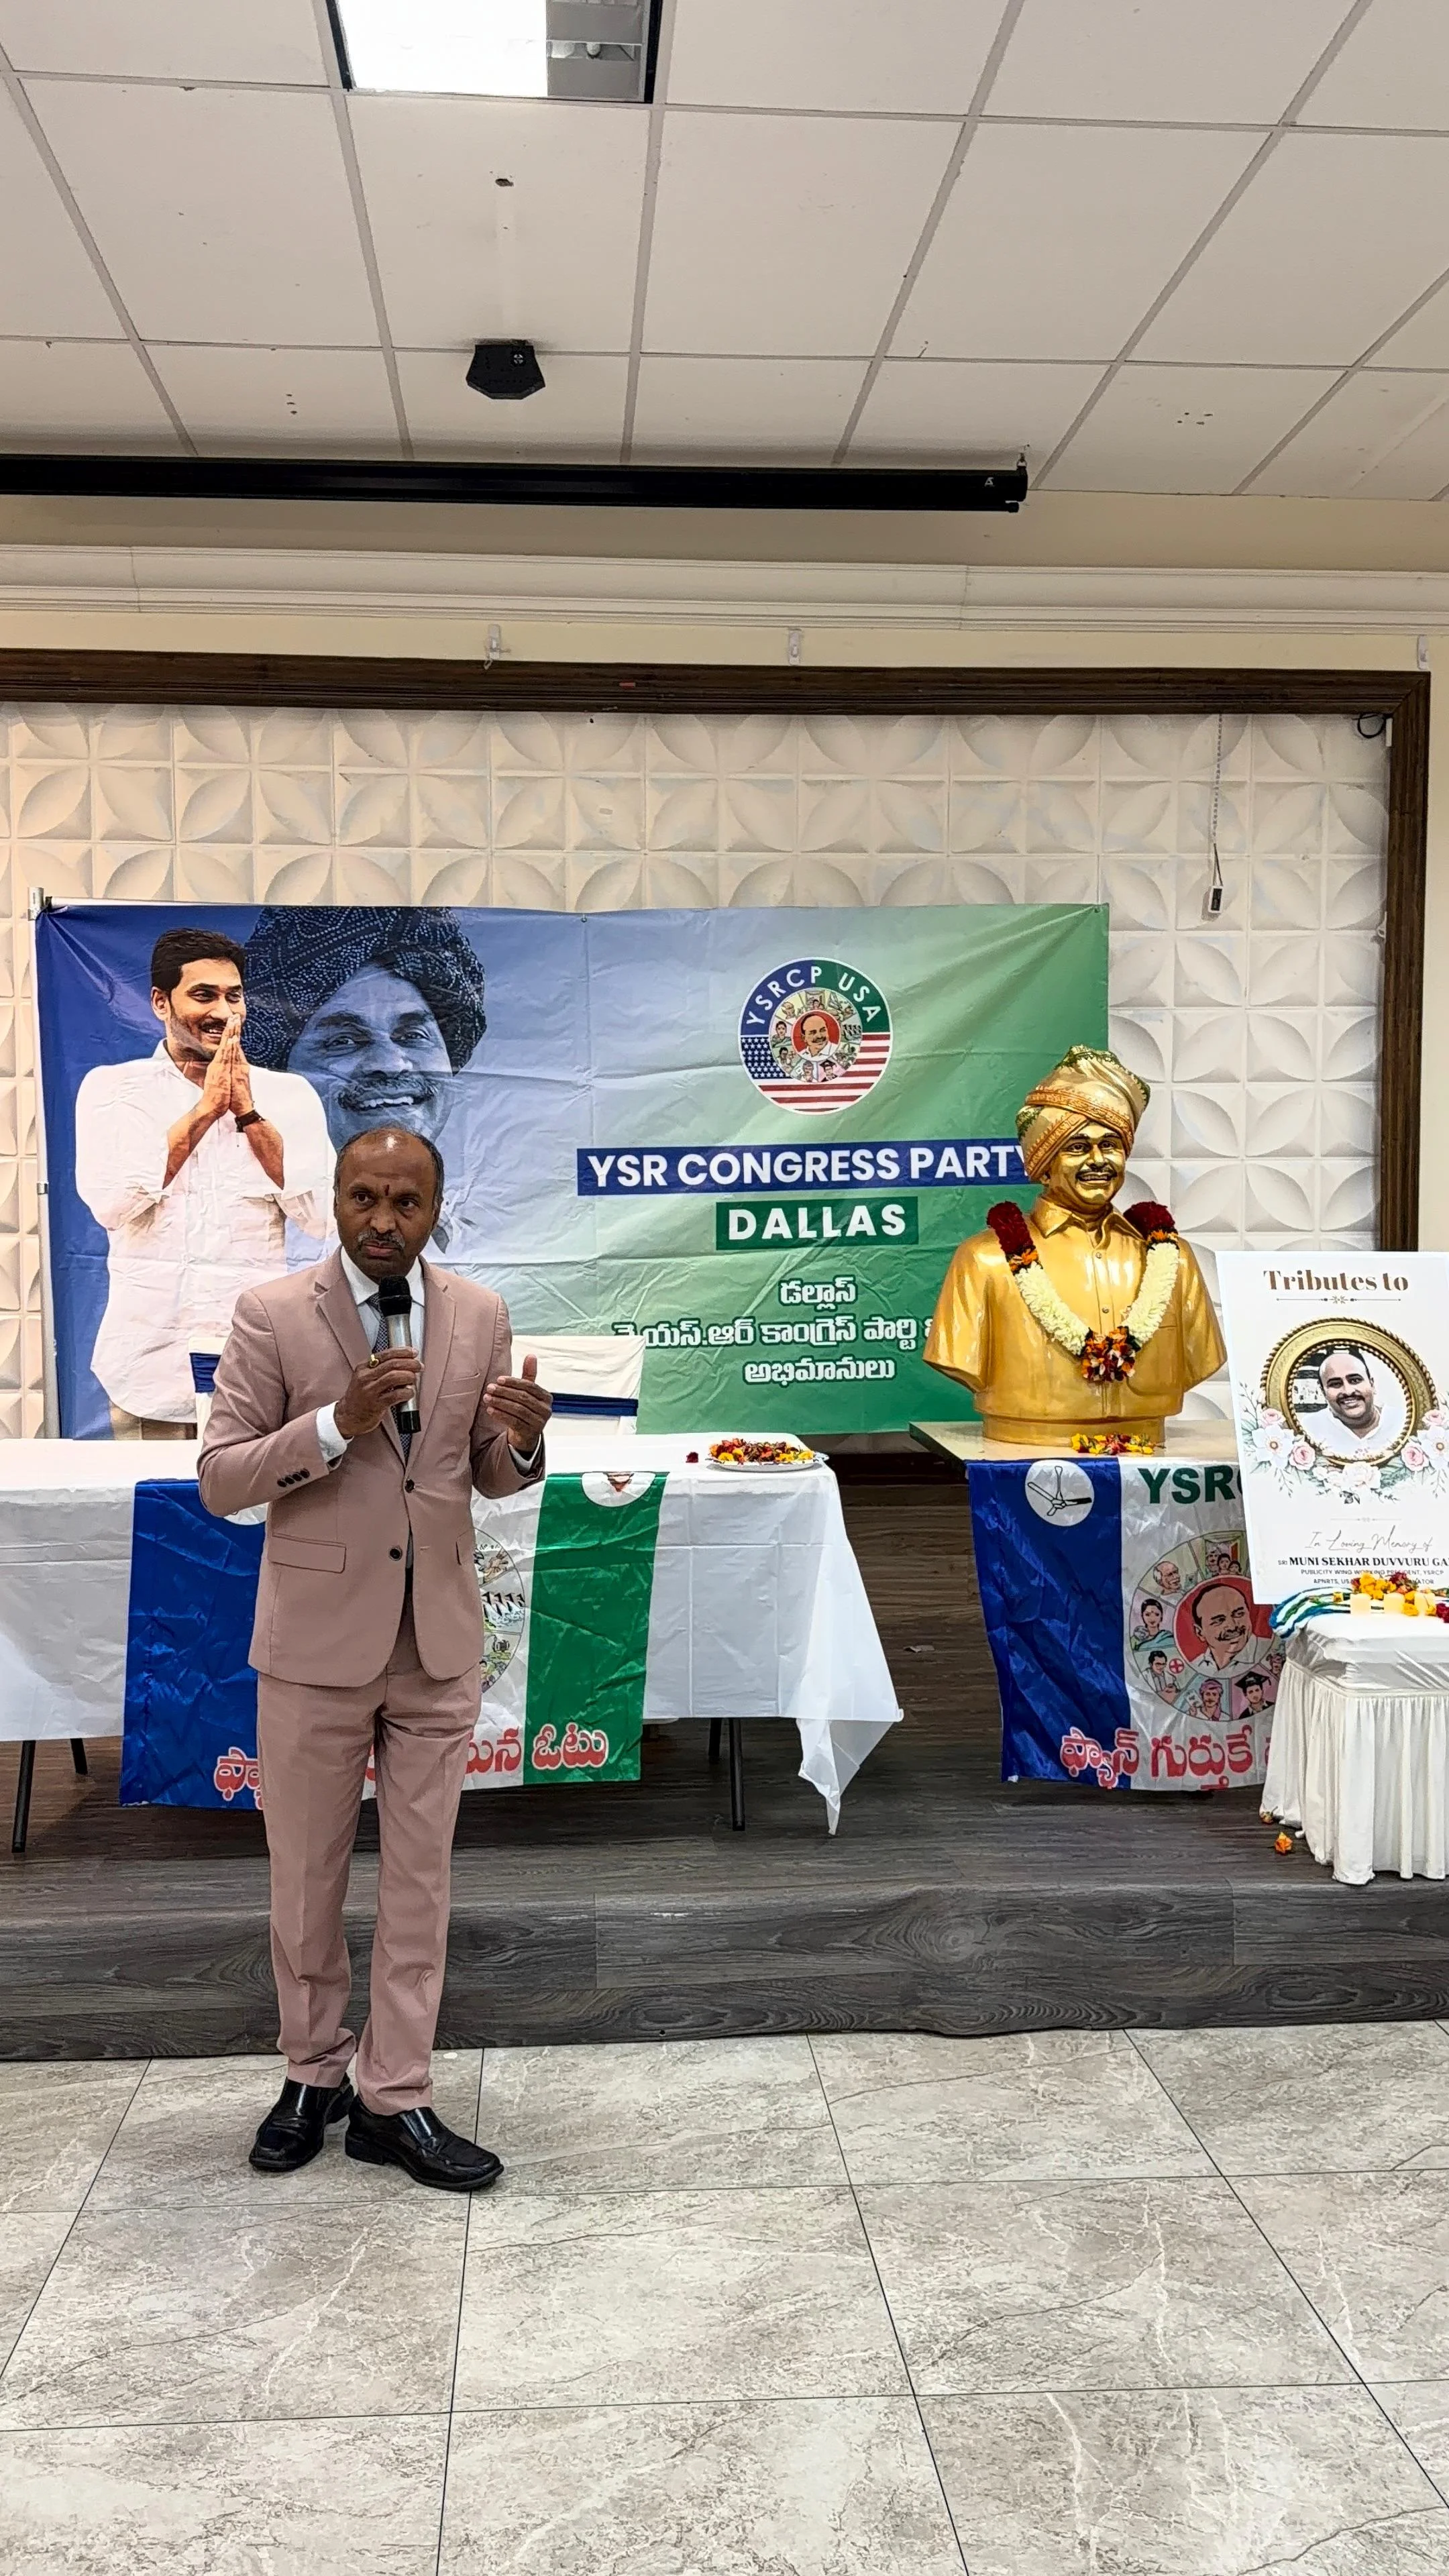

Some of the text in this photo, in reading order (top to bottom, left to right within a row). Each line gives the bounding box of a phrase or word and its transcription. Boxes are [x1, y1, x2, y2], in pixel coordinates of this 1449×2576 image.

[746, 966, 881, 1024] YSRCP USA
[587, 1155, 667, 1187] YSR
[678, 1148, 900, 1185] CONGRESS
[729, 1204, 906, 1240] DALLAS
[780, 1276, 857, 1311] డల్లాస్
[1263, 1269, 1408, 1291] Tributes to
[759, 1315, 857, 1346] కాంగ్రెస్
[744, 1356, 896, 1386] అభిమానులు
[1138, 1464, 1242, 1505] YSR
[1305, 1532, 1322, 1548] In
[1326, 1529, 1372, 1553] Loving
[1371, 1525, 1423, 1554] Memory
[1289, 1556, 1320, 1566] MUNI
[1322, 1556, 1370, 1566] SEKHAR
[1373, 1557, 1430, 1566] DUVVURU
[1432, 1557, 1449, 1566] GA
[532, 1723, 609, 1770] ఓటు
[1059, 1726, 1139, 1789] ఫ్యాన్
